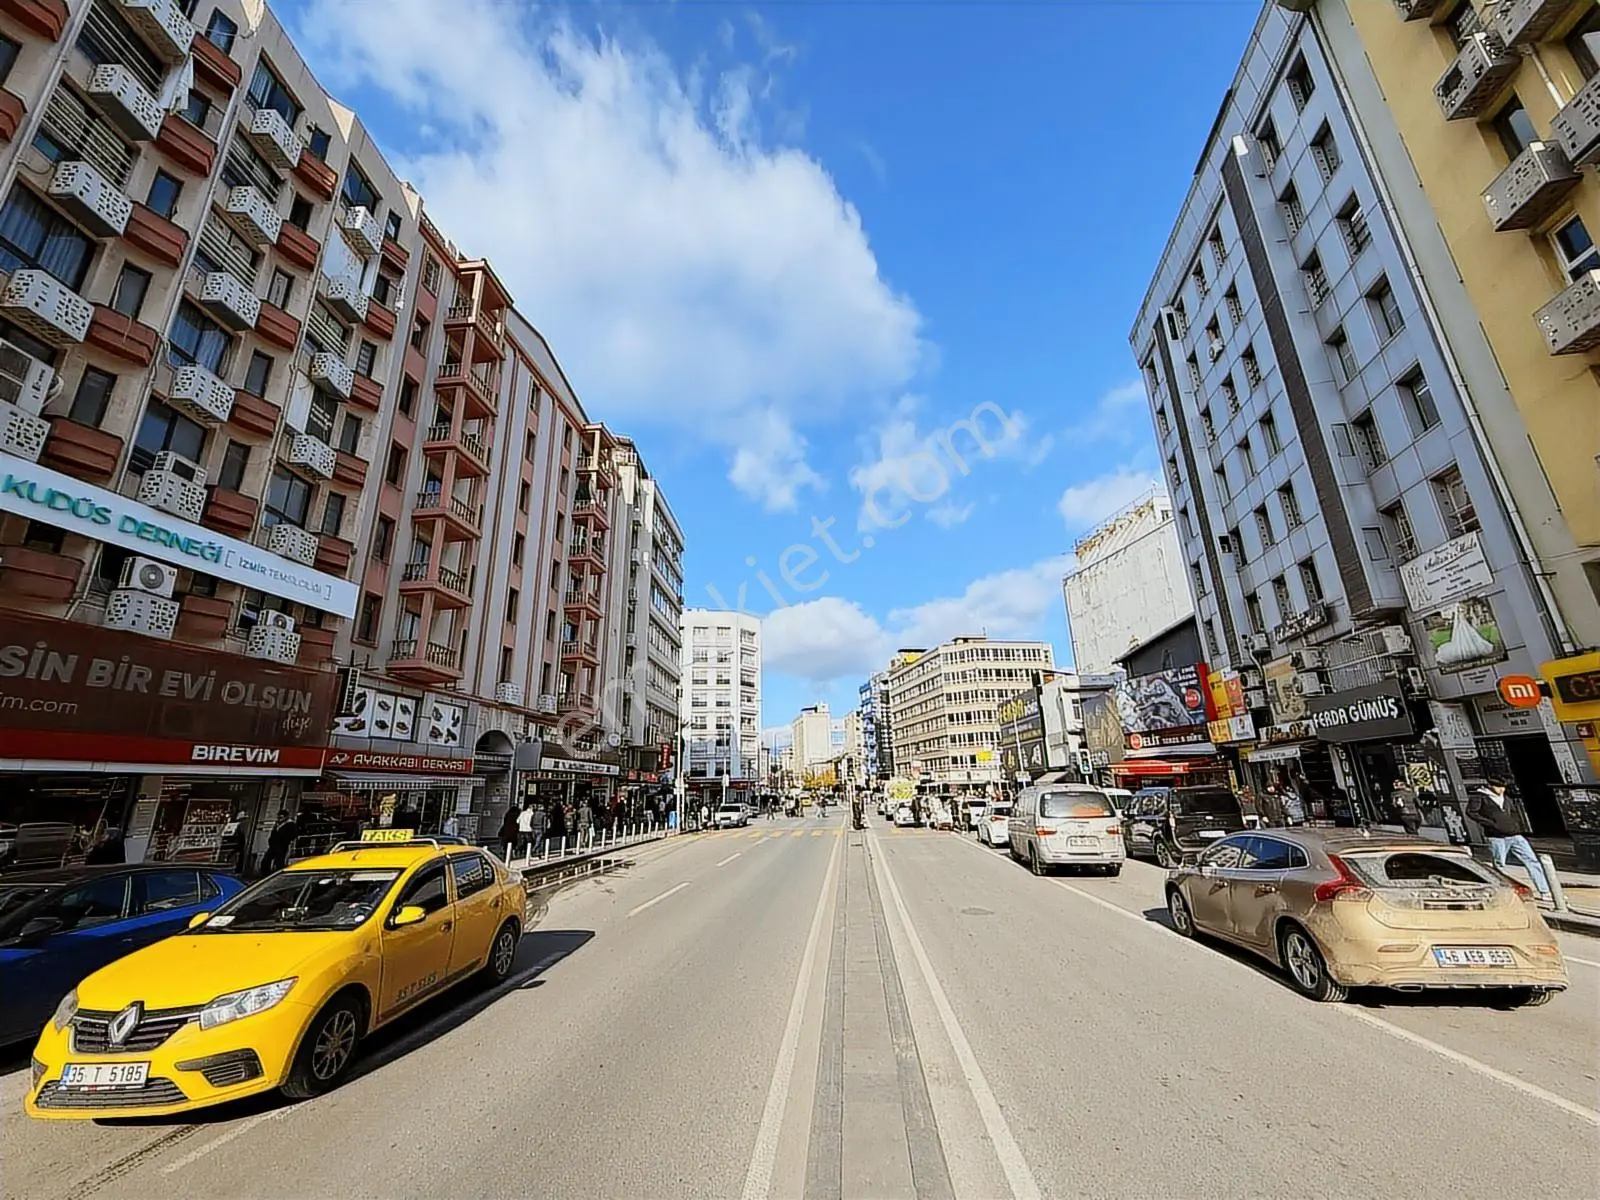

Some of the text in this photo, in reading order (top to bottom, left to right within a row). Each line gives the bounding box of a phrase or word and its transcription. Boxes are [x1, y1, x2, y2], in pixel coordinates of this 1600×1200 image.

[1, 474, 112, 525] KUDÜS
[118, 514, 224, 563] DERNEĞİ
[239, 556, 267, 575] İZMİR
[86, 654, 152, 694] BİR
[159, 670, 217, 701] EVİ
[221, 678, 312, 714] OLSUN
[1312, 695, 1399, 729] FERDA GÜMÜŞ
[191, 744, 281, 764] BİREVİM
[353, 754, 466, 771] AYAKKABI DERYASI
[69, 1065, 143, 1083] 35 T 5185
